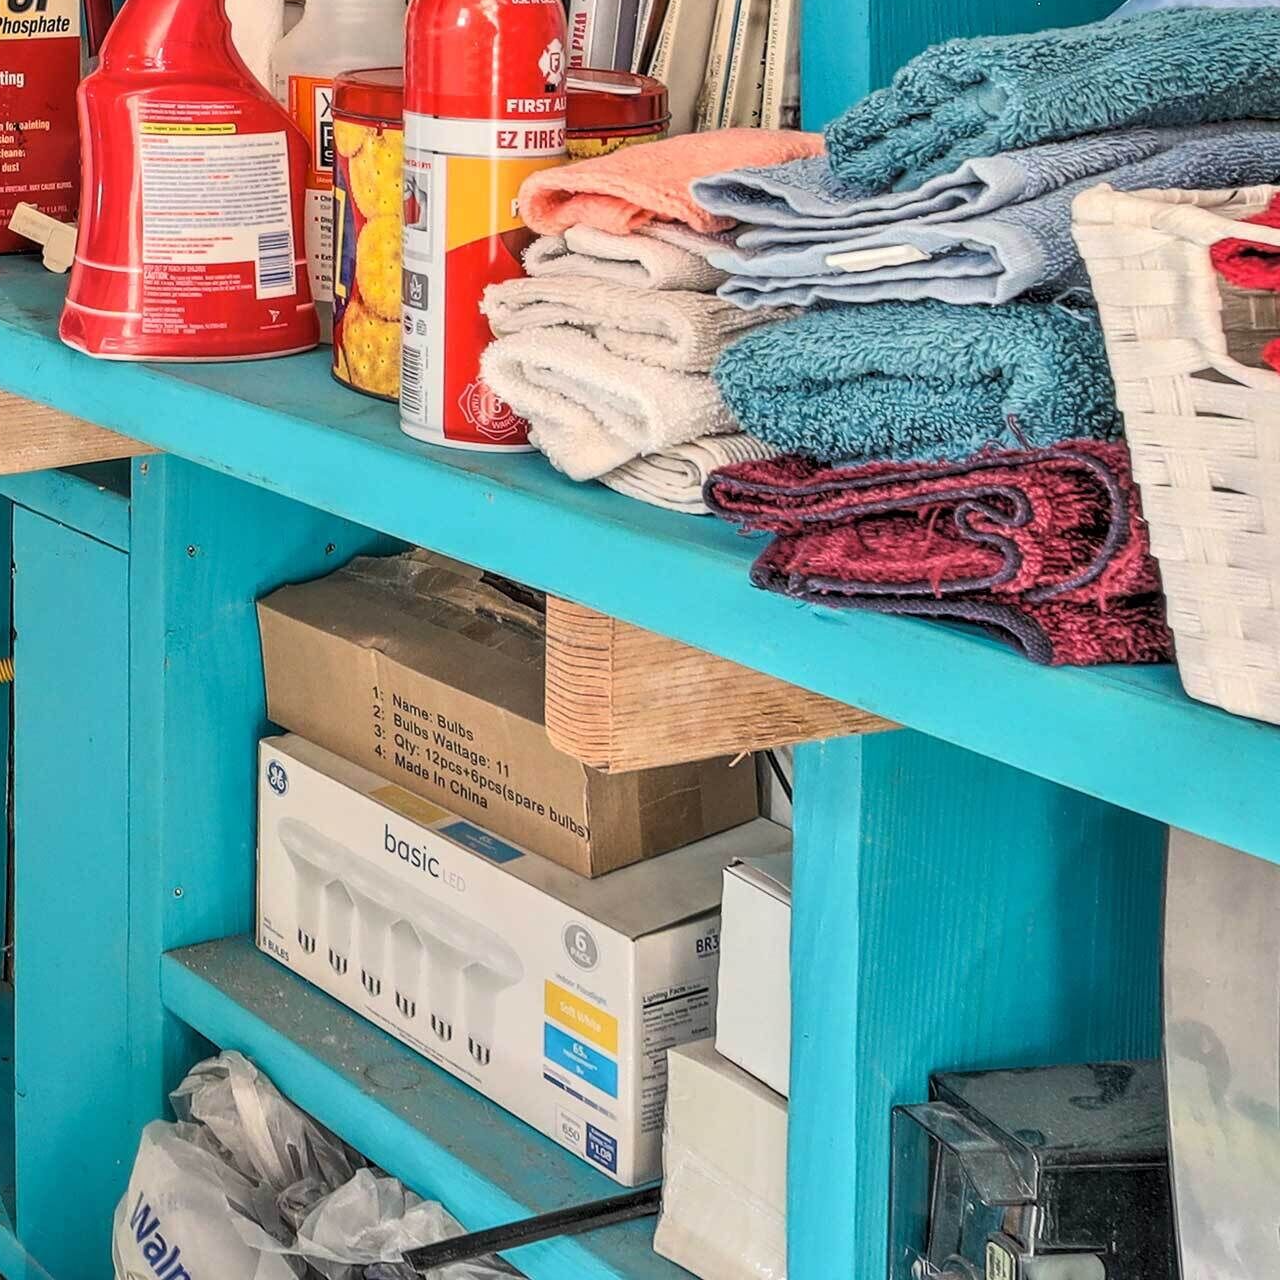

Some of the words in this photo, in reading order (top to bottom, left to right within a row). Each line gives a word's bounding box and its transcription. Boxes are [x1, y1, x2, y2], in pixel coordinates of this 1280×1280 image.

[572, 12, 588, 50] Wild
[506, 99, 552, 113] FIRST
[496, 131, 518, 149] EZ
[524, 131, 554, 149] FIRE
[2, 161, 19, 172] dust
[392, 694, 433, 721] Name:
[437, 715, 474, 741] Bulbs
[393, 714, 429, 740] Bulbs
[432, 733, 490, 769] Wattage:
[496, 761, 510, 778] 11
[394, 753, 429, 780] Made
[450, 779, 488, 809] China
[394, 733, 420, 757] Qty:
[549, 806, 590, 841] bulbs)
[384, 823, 440, 878] basic
[442, 868, 466, 893] LED
[574, 931, 587, 952] 6
